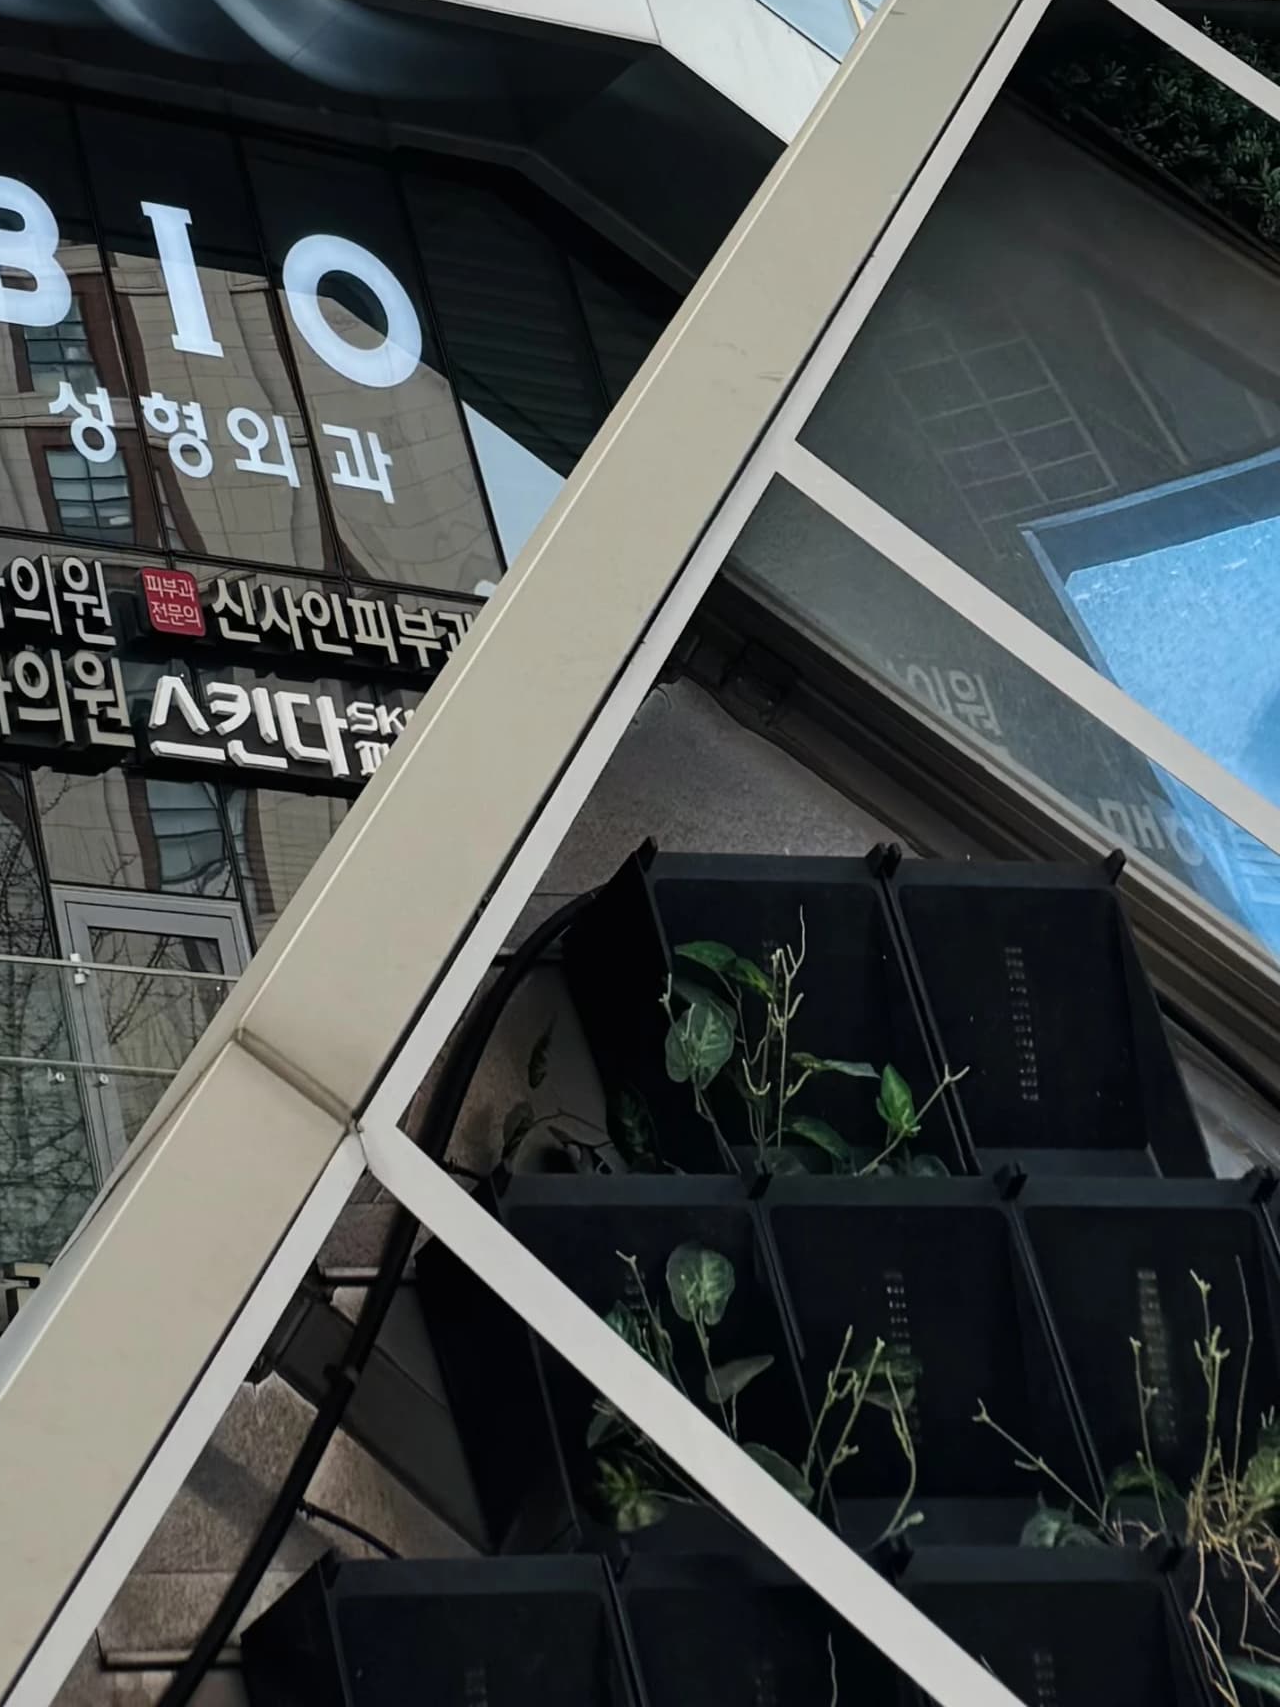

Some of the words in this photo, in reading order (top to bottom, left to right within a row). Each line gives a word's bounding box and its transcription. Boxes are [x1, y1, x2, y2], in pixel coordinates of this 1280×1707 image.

[48, 380, 396, 504] 성형외과
[144, 574, 195, 603] 피부과
[150, 602, 202, 629] 전문의
[147, 675, 349, 778] 스킨다
[345, 701, 417, 737] SK
